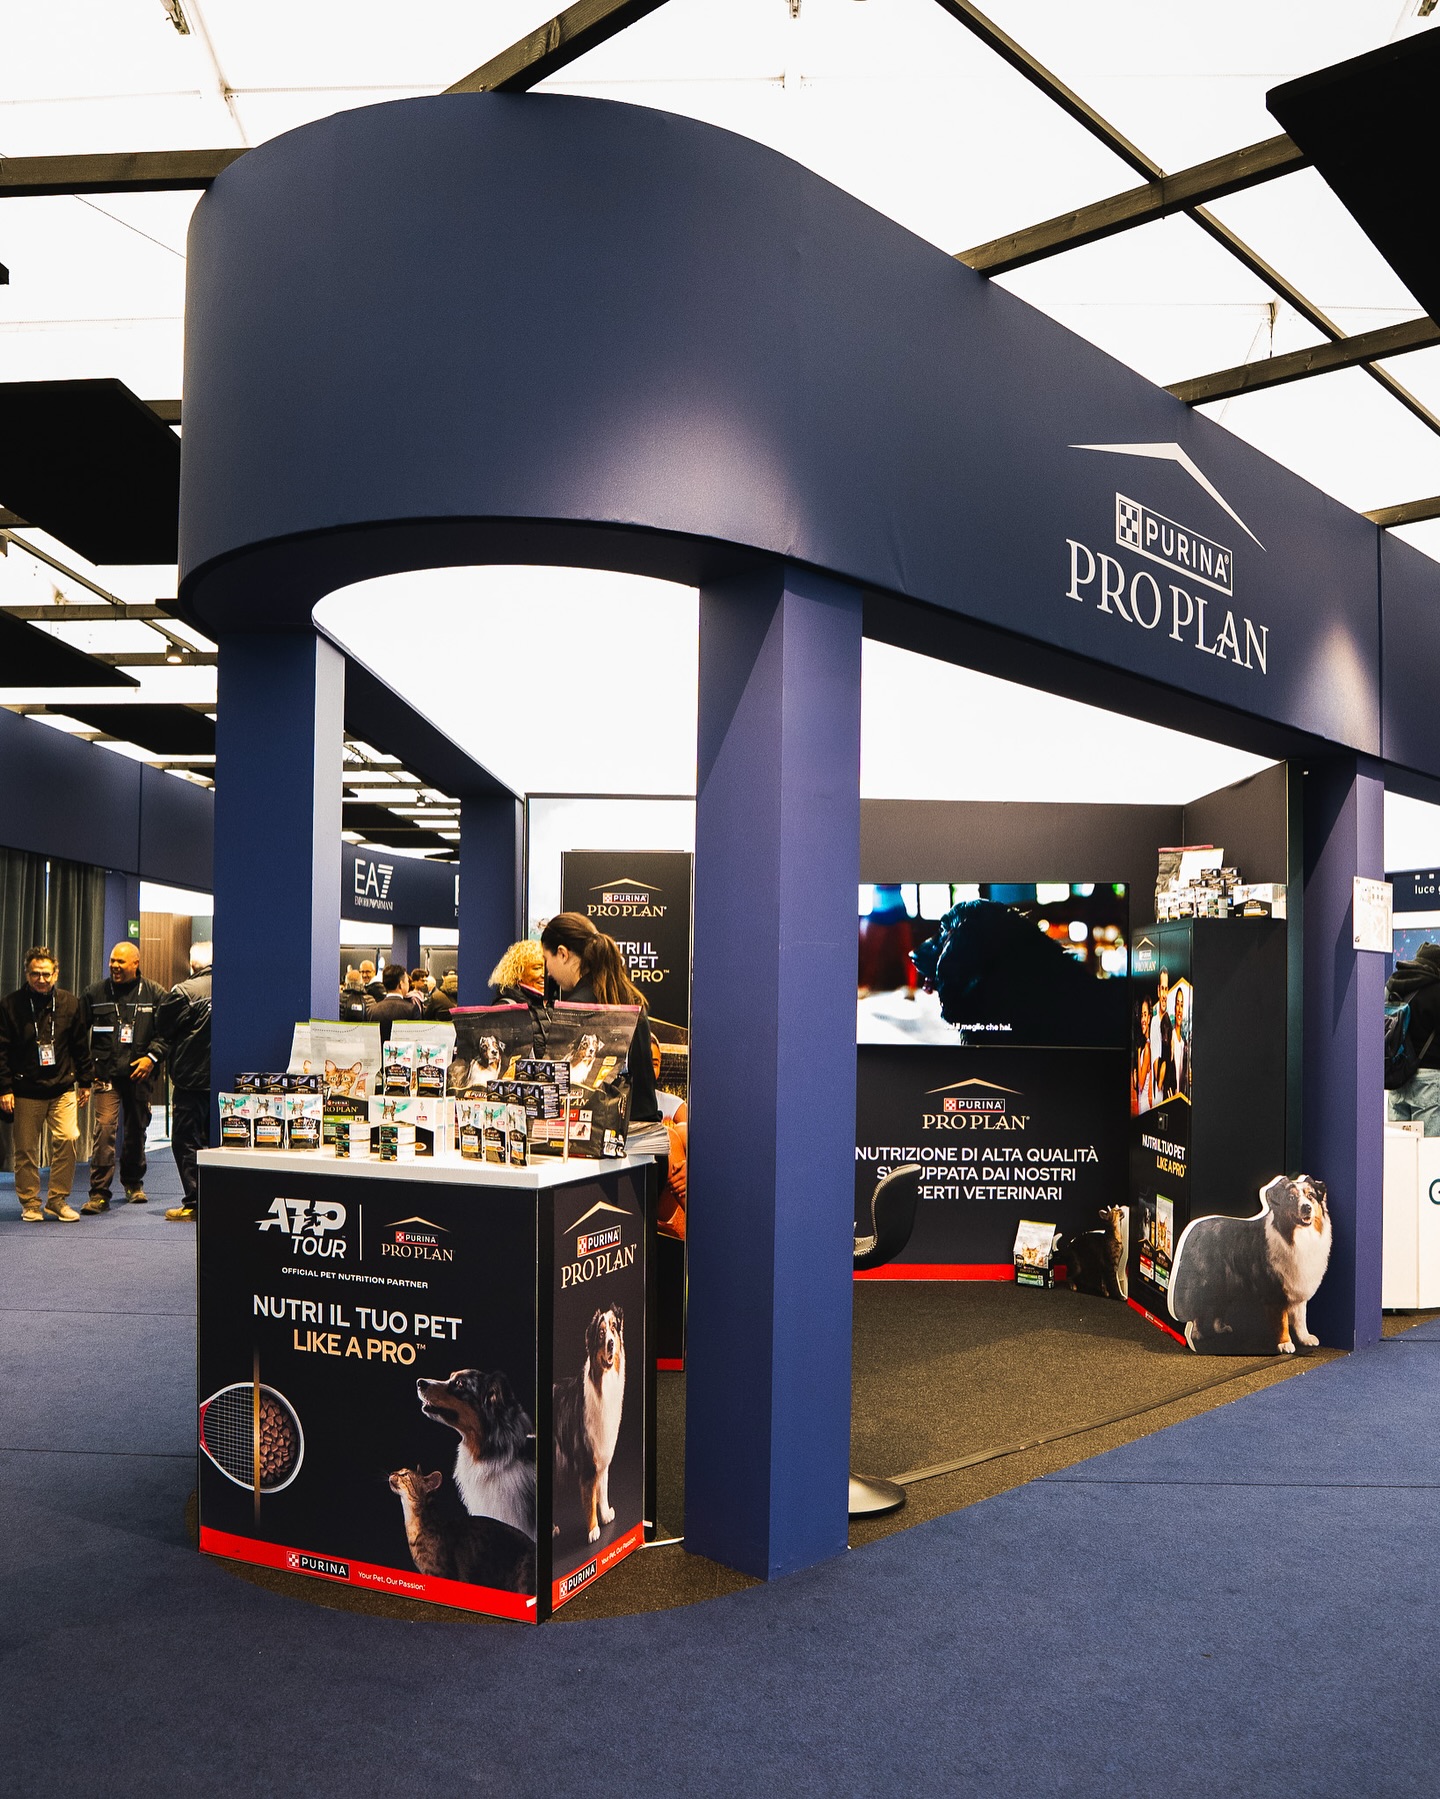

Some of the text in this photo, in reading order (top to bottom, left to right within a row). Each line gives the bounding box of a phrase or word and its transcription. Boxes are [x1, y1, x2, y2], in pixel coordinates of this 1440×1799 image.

[1066, 538, 1270, 675] PRO PLAN
[354, 858, 394, 899] EA7
[1414, 884, 1435, 895] luce
[587, 904, 665, 918] PRO PLAN
[643, 941, 657, 955] IL
[628, 955, 659, 969] PET
[961, 1022, 985, 1032] meglio
[985, 1022, 999, 1031] che
[922, 1114, 1026, 1130] PRO PLAN
[855, 1145, 1099, 1163] NUTRIZIONE DI ALTA QUALITÀ
[1161, 1139, 1173, 1157] TUO
[1173, 1144, 1186, 1161] PET
[1156, 1155, 1168, 1172] LIKE
[1167, 1160, 1173, 1173] A
[982, 1167, 1009, 1181] DAI
[1014, 1167, 1076, 1181] NOSTRI
[963, 1187, 1062, 1201] VETERINARI
[254, 1197, 347, 1237] ATP
[291, 1235, 347, 1259] TOUR
[405, 1234, 436, 1244] PURINA
[381, 1243, 454, 1262] PRO PLAN
[561, 1244, 636, 1289] PRO PLAN
[281, 1266, 429, 1289] OFFICIAL PET NUTRITION PARTNER
[253, 1294, 463, 1340] NUTRI IL TUO PET
[293, 1329, 342, 1356] LIKE
[345, 1336, 363, 1359] A
[301, 1556, 347, 1576] PURINA
[358, 1571, 372, 1580] Your
[386, 1576, 398, 1585] Our
[568, 1563, 595, 1590] PURINA
